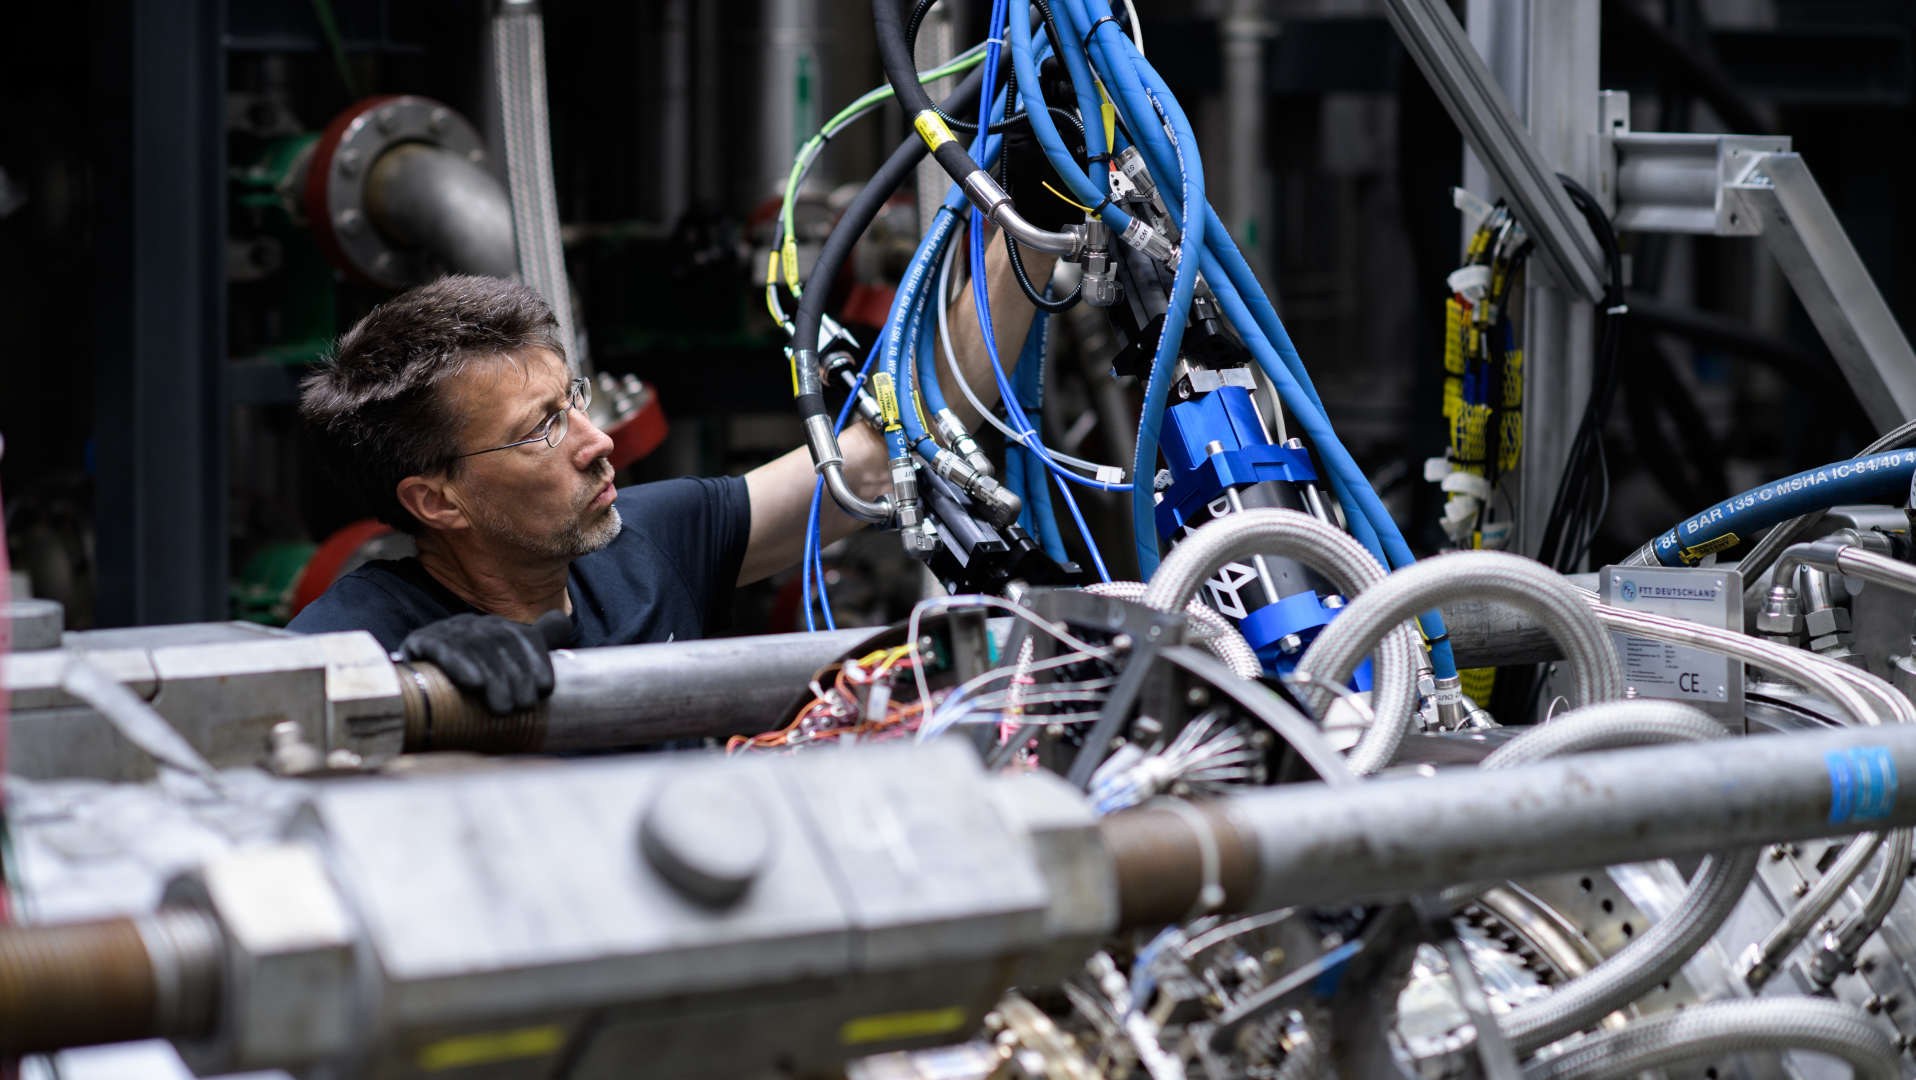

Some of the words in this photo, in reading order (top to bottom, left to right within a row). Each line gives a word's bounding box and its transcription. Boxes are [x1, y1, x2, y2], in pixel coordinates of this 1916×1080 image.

[1686, 508, 1723, 534] BAR
[1776, 471, 1829, 496] MSHA
[1832, 454, 1901, 480] IC-84/40
[1639, 586, 1653, 595] FTT
[1655, 586, 1717, 597] DEUTSCHLAND
[1679, 672, 1700, 693] CE
